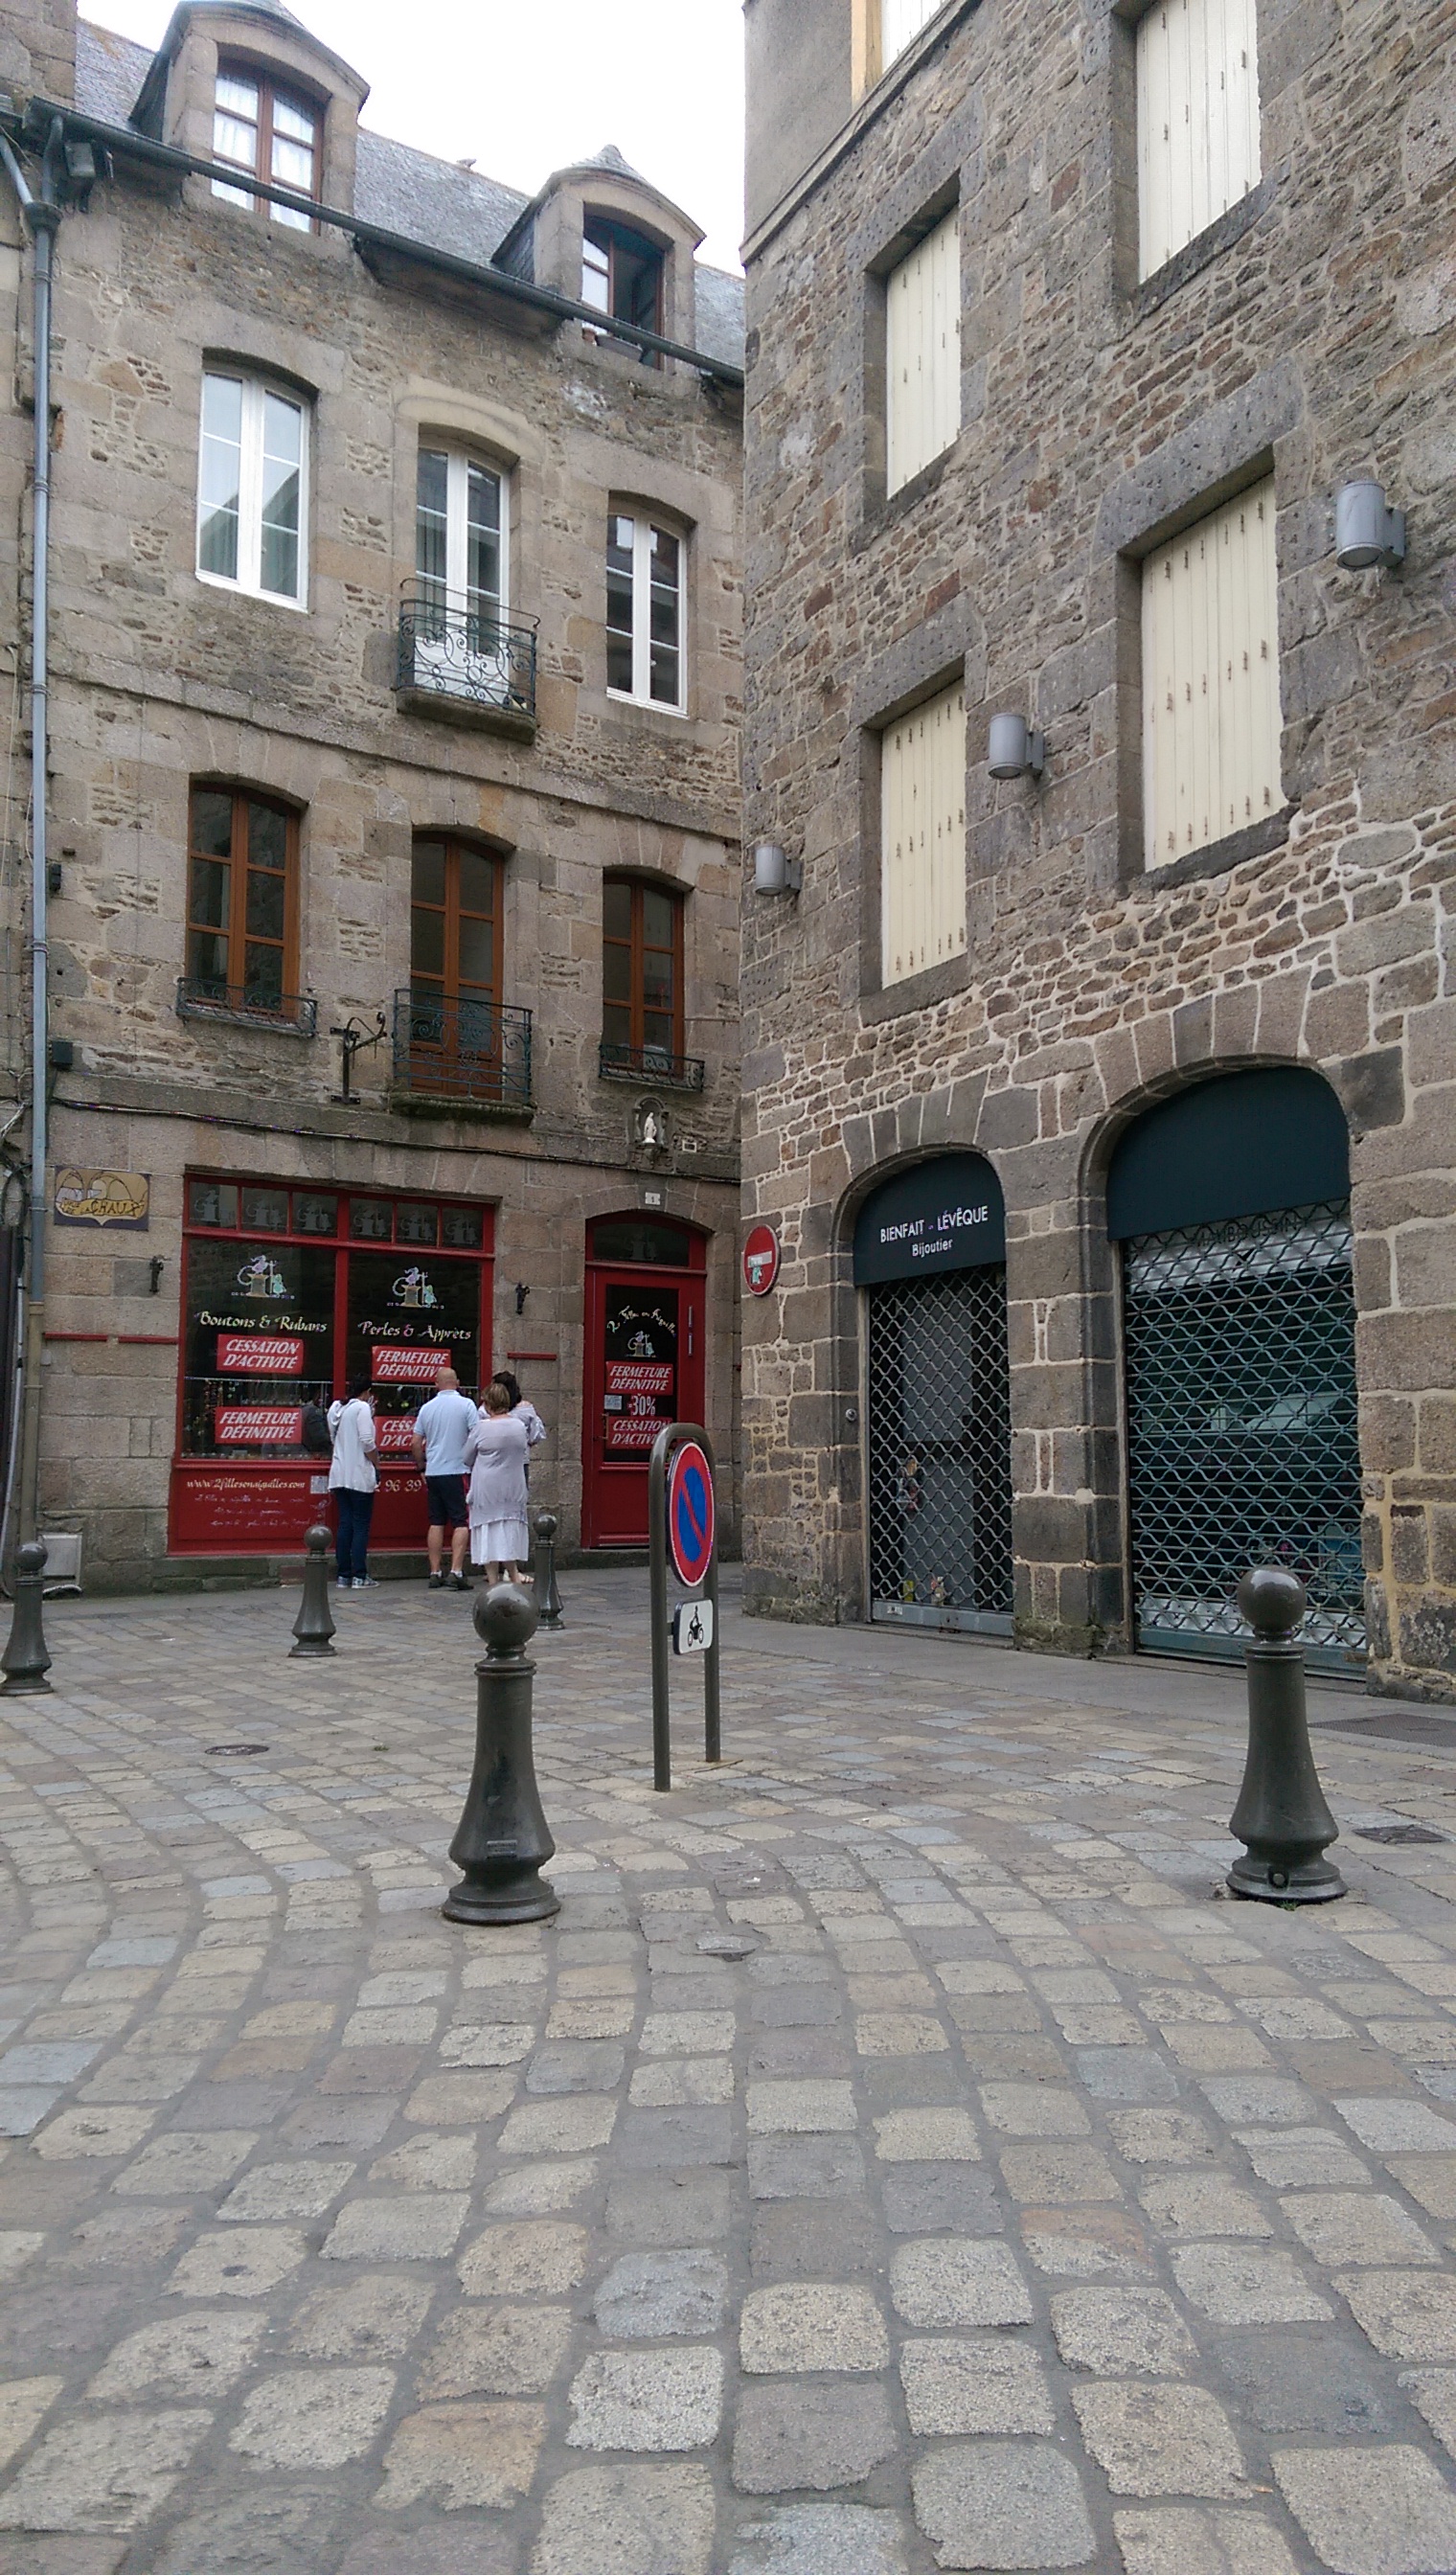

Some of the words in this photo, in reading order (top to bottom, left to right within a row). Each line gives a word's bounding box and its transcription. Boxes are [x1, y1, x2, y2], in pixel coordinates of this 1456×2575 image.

[880, 1219, 925, 1243] BIENFAIT
[937, 1205, 989, 1231] LÉVÊQUE
[912, 1238, 953, 1258] Bijoutier
[194, 1310, 256, 1328] Boutons
[260, 1315, 271, 1329] &
[275, 1315, 328, 1333] Rubans
[357, 1321, 400, 1336] Perles
[403, 1324, 415, 1337] &
[226, 1339, 300, 1355] CESSATION
[223, 1354, 298, 1369] D'ACTIVITÉ
[376, 1350, 448, 1365] FERMETURE
[376, 1362, 443, 1378] DÉFINITIV
[610, 1365, 671, 1379] FERMETURE
[610, 1378, 669, 1391] DÉFINITIVE
[628, 1396, 655, 1416] -30%
[219, 1411, 299, 1424] FERMETURE
[219, 1424, 296, 1439] DÉFINITIVE
[382, 1420, 414, 1432] CESS
[380, 1434, 413, 1447] D'AC
[385, 1479, 401, 1493] 96
[404, 1479, 421, 1493] 39
